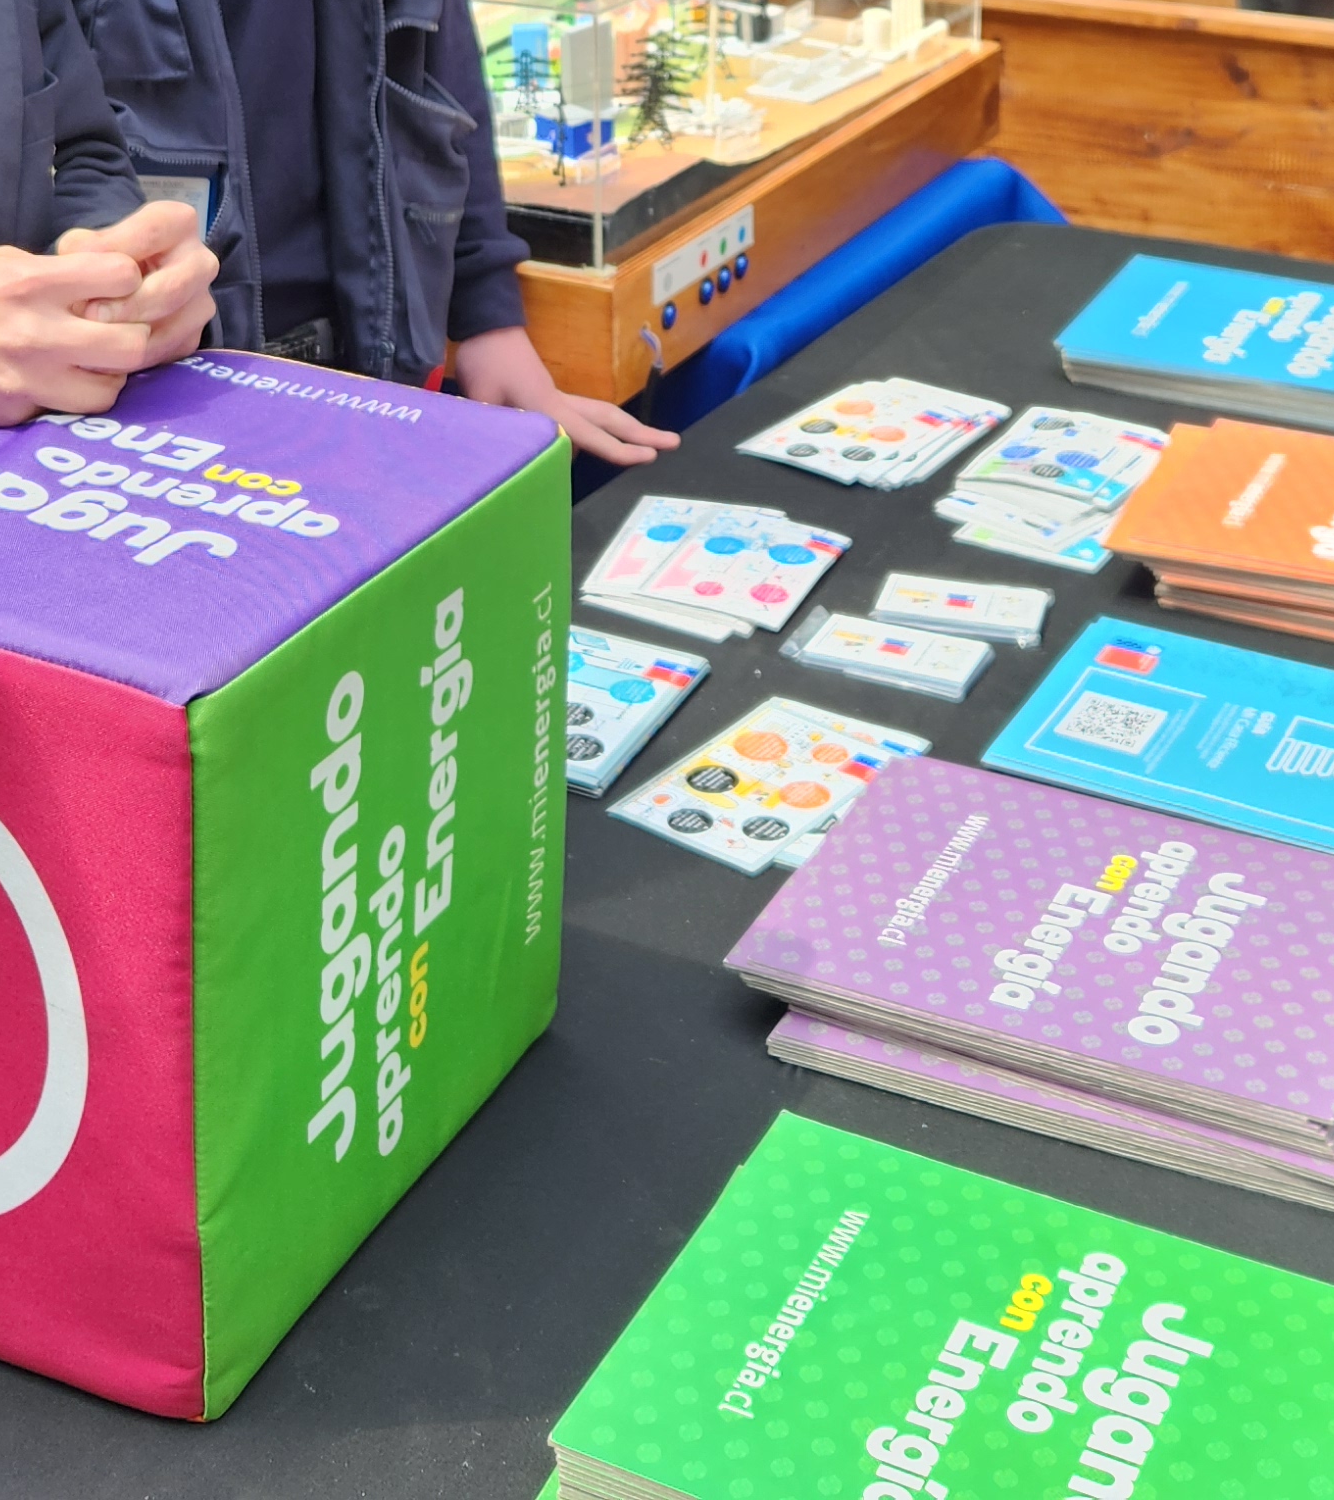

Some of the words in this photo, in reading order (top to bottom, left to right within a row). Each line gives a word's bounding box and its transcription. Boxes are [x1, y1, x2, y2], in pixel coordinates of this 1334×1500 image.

[35, 446, 340, 539] aprendo
[203, 464, 303, 497] con
[414, 586, 473, 939] Energía
[523, 581, 555, 946] www.mienergia.cl
[307, 669, 371, 1162] Jugando
[876, 812, 991, 948] www.mienergia.cl
[988, 882, 1115, 1012] Energía
[1096, 853, 1139, 892] con
[1103, 840, 1198, 956] aprendo
[369, 823, 412, 1159] aprendo
[407, 942, 430, 1049] con
[1128, 871, 1270, 1048] Jugando
[716, 1209, 871, 1420] www.mienergia.cl
[999, 1270, 1054, 1333] con
[1005, 1249, 1129, 1435] aprendo
[1064, 1301, 1213, 1499] Jugan
